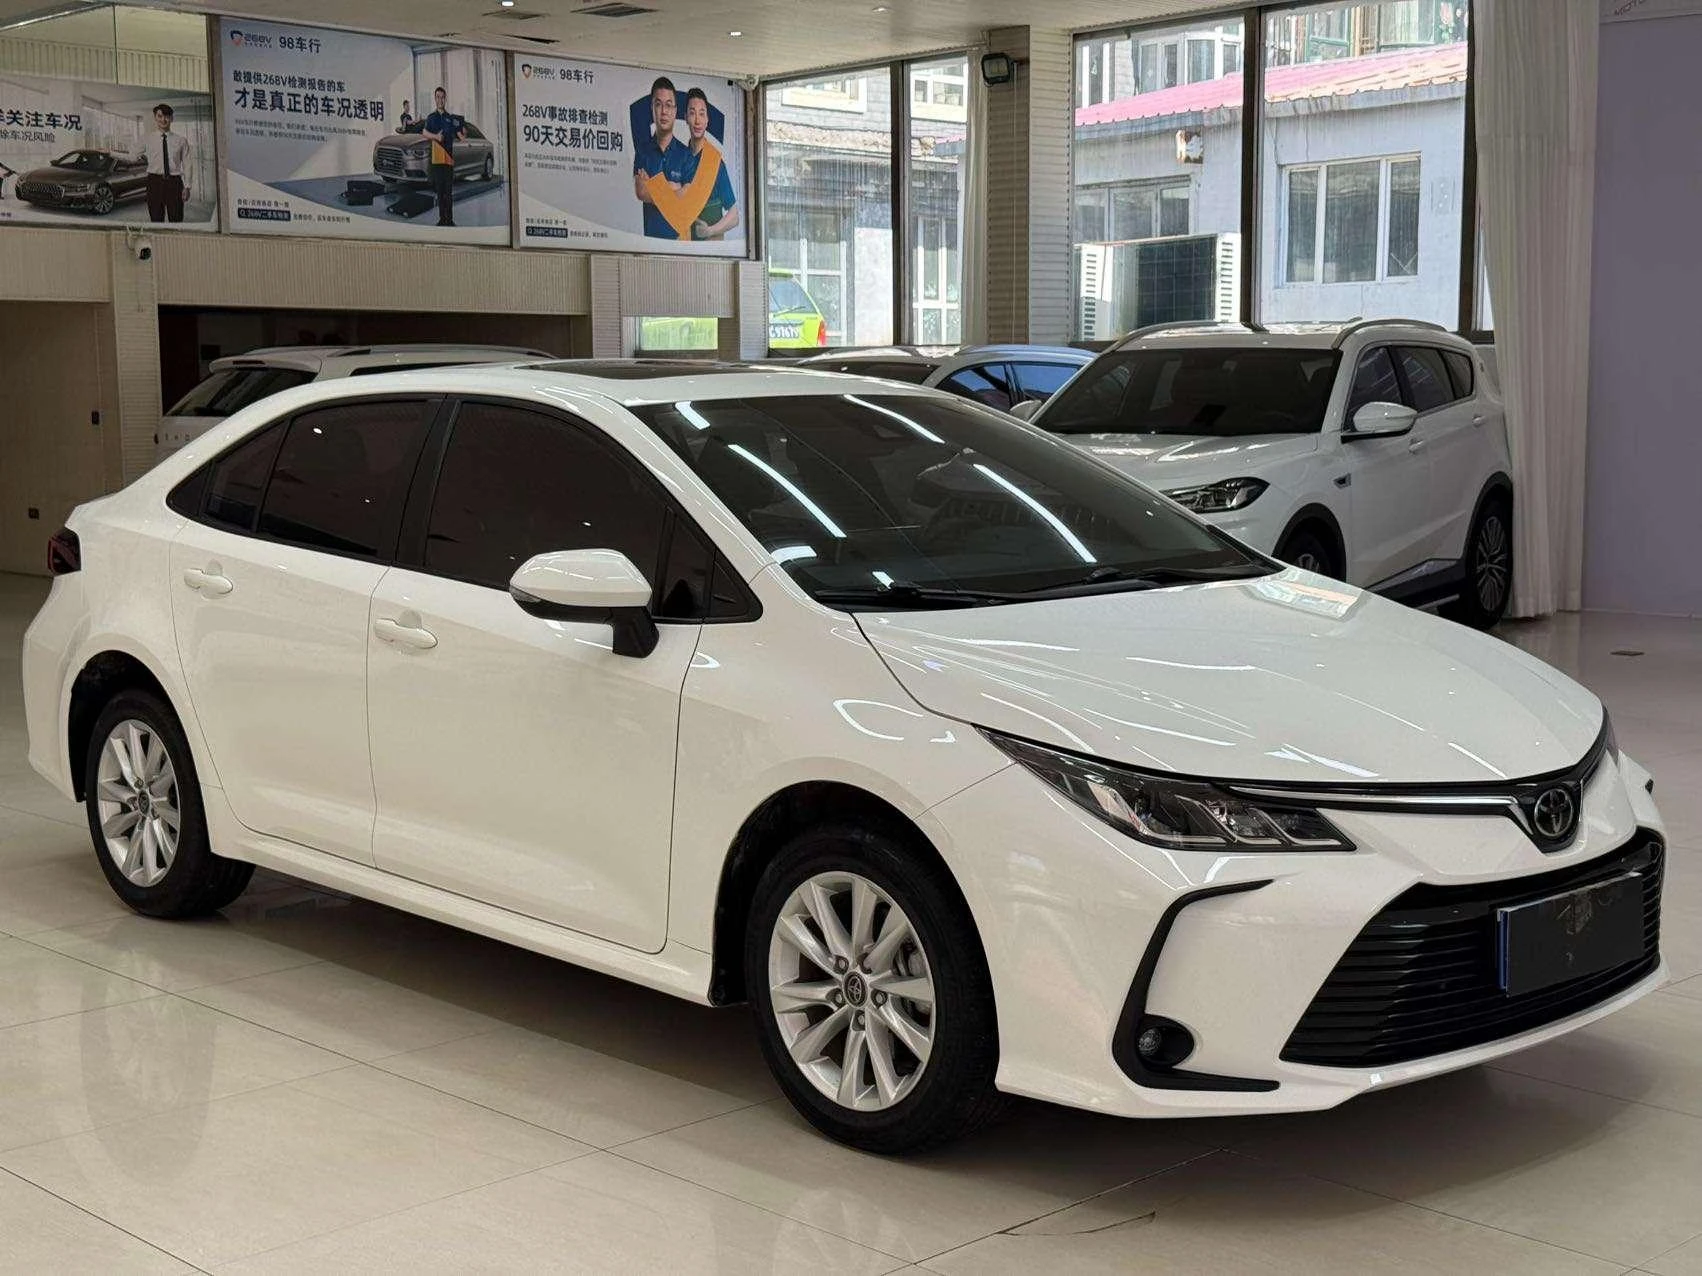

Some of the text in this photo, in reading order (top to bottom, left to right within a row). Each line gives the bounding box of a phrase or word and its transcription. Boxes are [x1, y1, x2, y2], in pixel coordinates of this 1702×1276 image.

[278, 36, 322, 54] 98车行
[233, 70, 346, 93] 敢提供268V检测报告的车
[559, 69, 594, 84] 98车行
[234, 87, 385, 122] 才是真正的车况透明
[522, 104, 608, 126] 268V事故排查检测
[523, 125, 623, 152] 90天交易价回购
